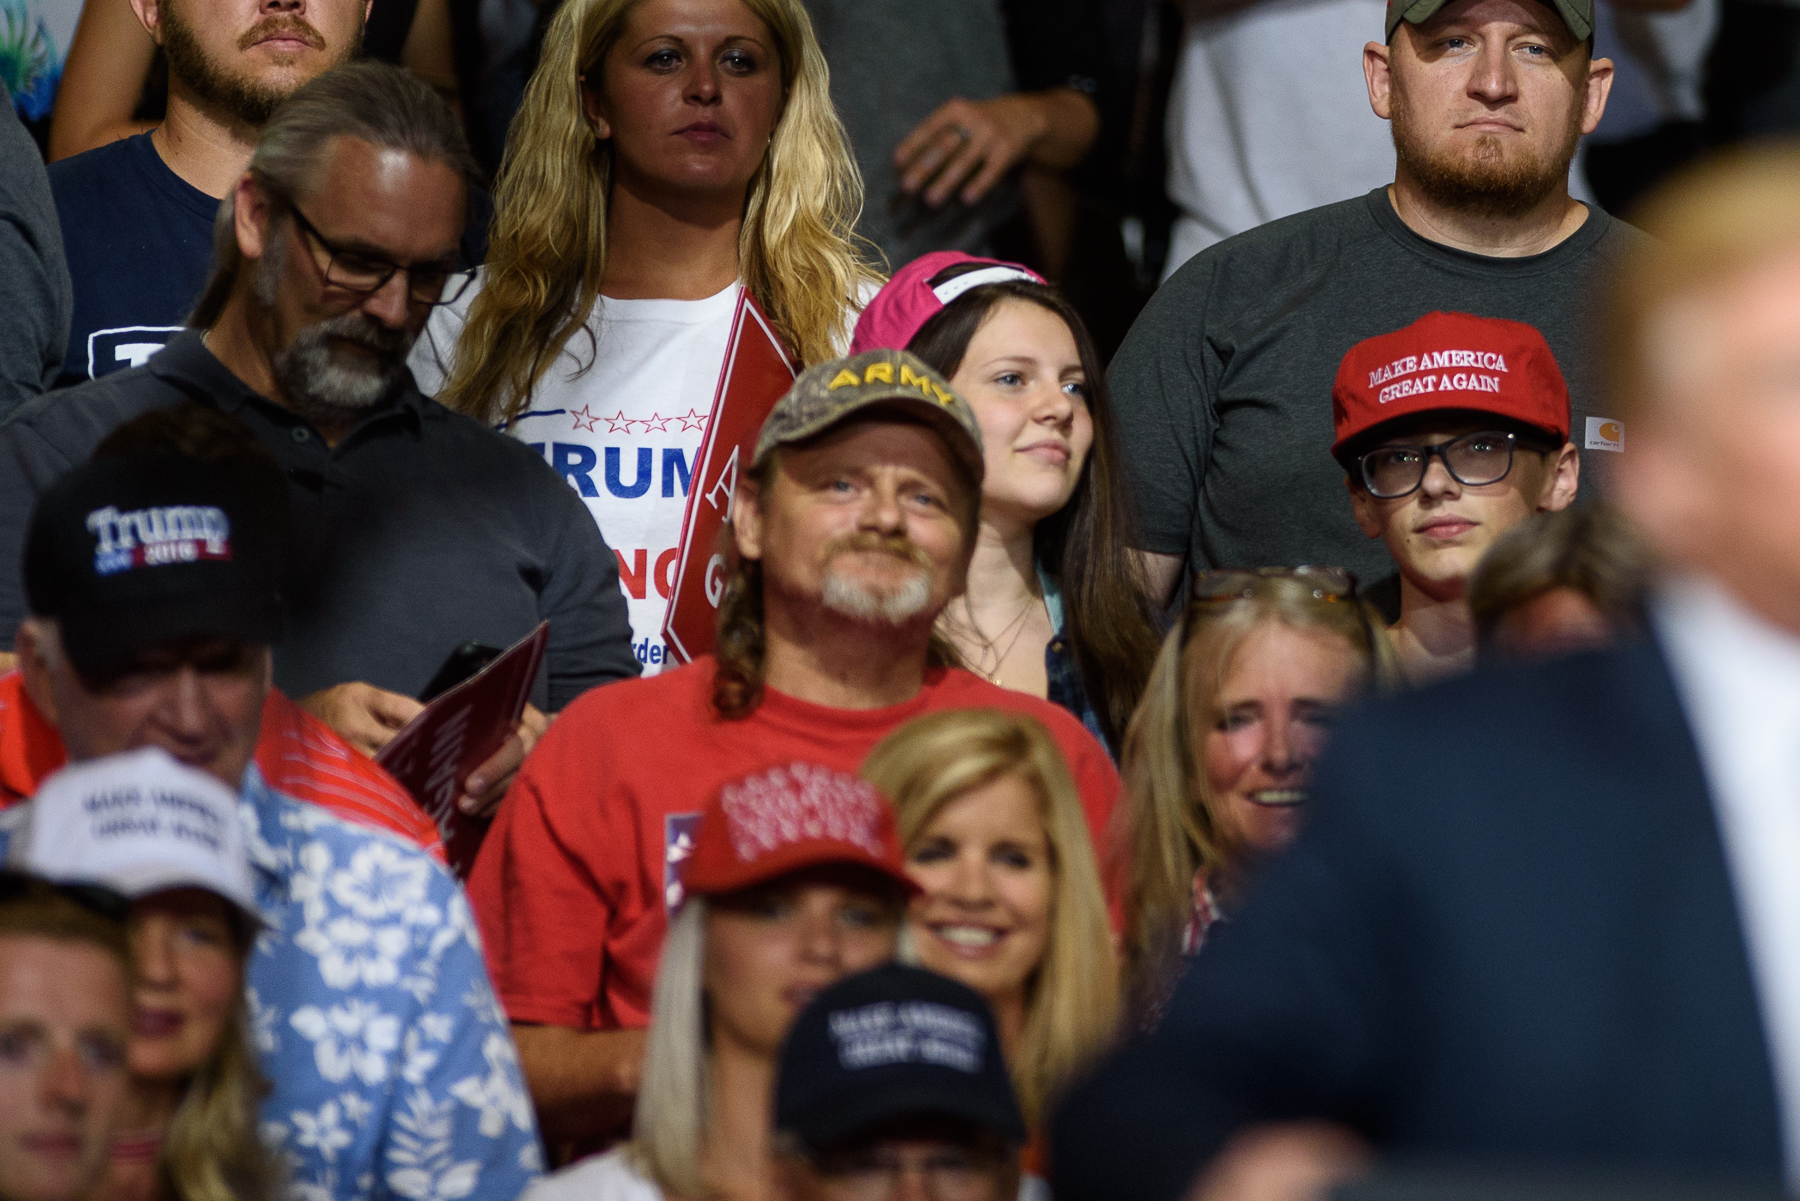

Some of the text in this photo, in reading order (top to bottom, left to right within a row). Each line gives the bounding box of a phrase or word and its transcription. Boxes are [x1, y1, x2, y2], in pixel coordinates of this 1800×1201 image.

[828, 362, 954, 406] ARMY
[1368, 349, 1509, 389] MAKE AMERICA
[1378, 372, 1500, 404] GREAT AGAIN
[527, 441, 702, 499] RUM
[85, 504, 231, 555] Trump
